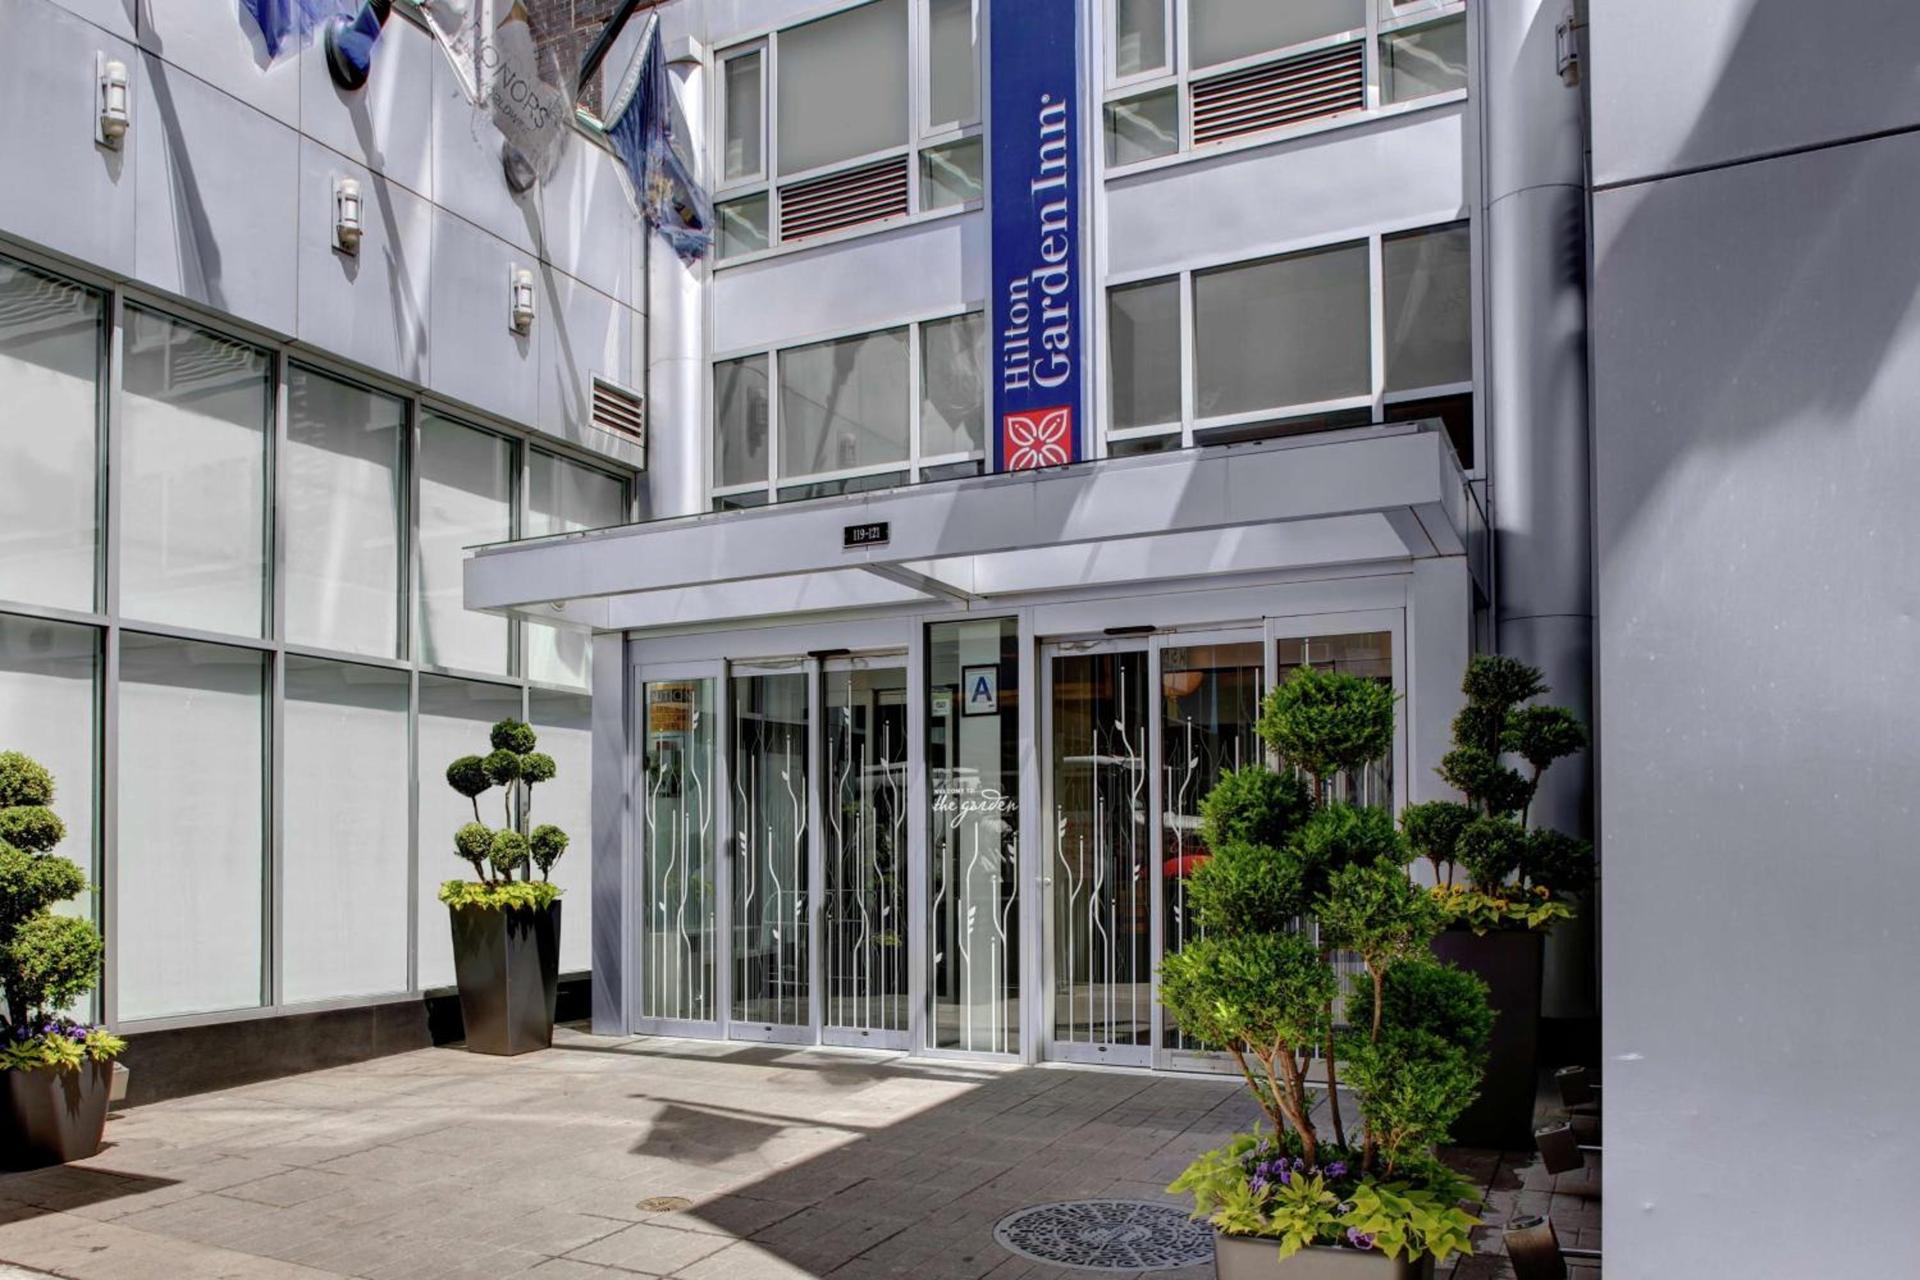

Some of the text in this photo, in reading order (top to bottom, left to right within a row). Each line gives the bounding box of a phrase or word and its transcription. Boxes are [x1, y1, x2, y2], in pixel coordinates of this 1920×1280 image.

[1031, 98, 1070, 387] Garden Inn
[1004, 276, 1030, 393] Hilton
[971, 676, 993, 703] A
[933, 788, 1018, 829] the garden
